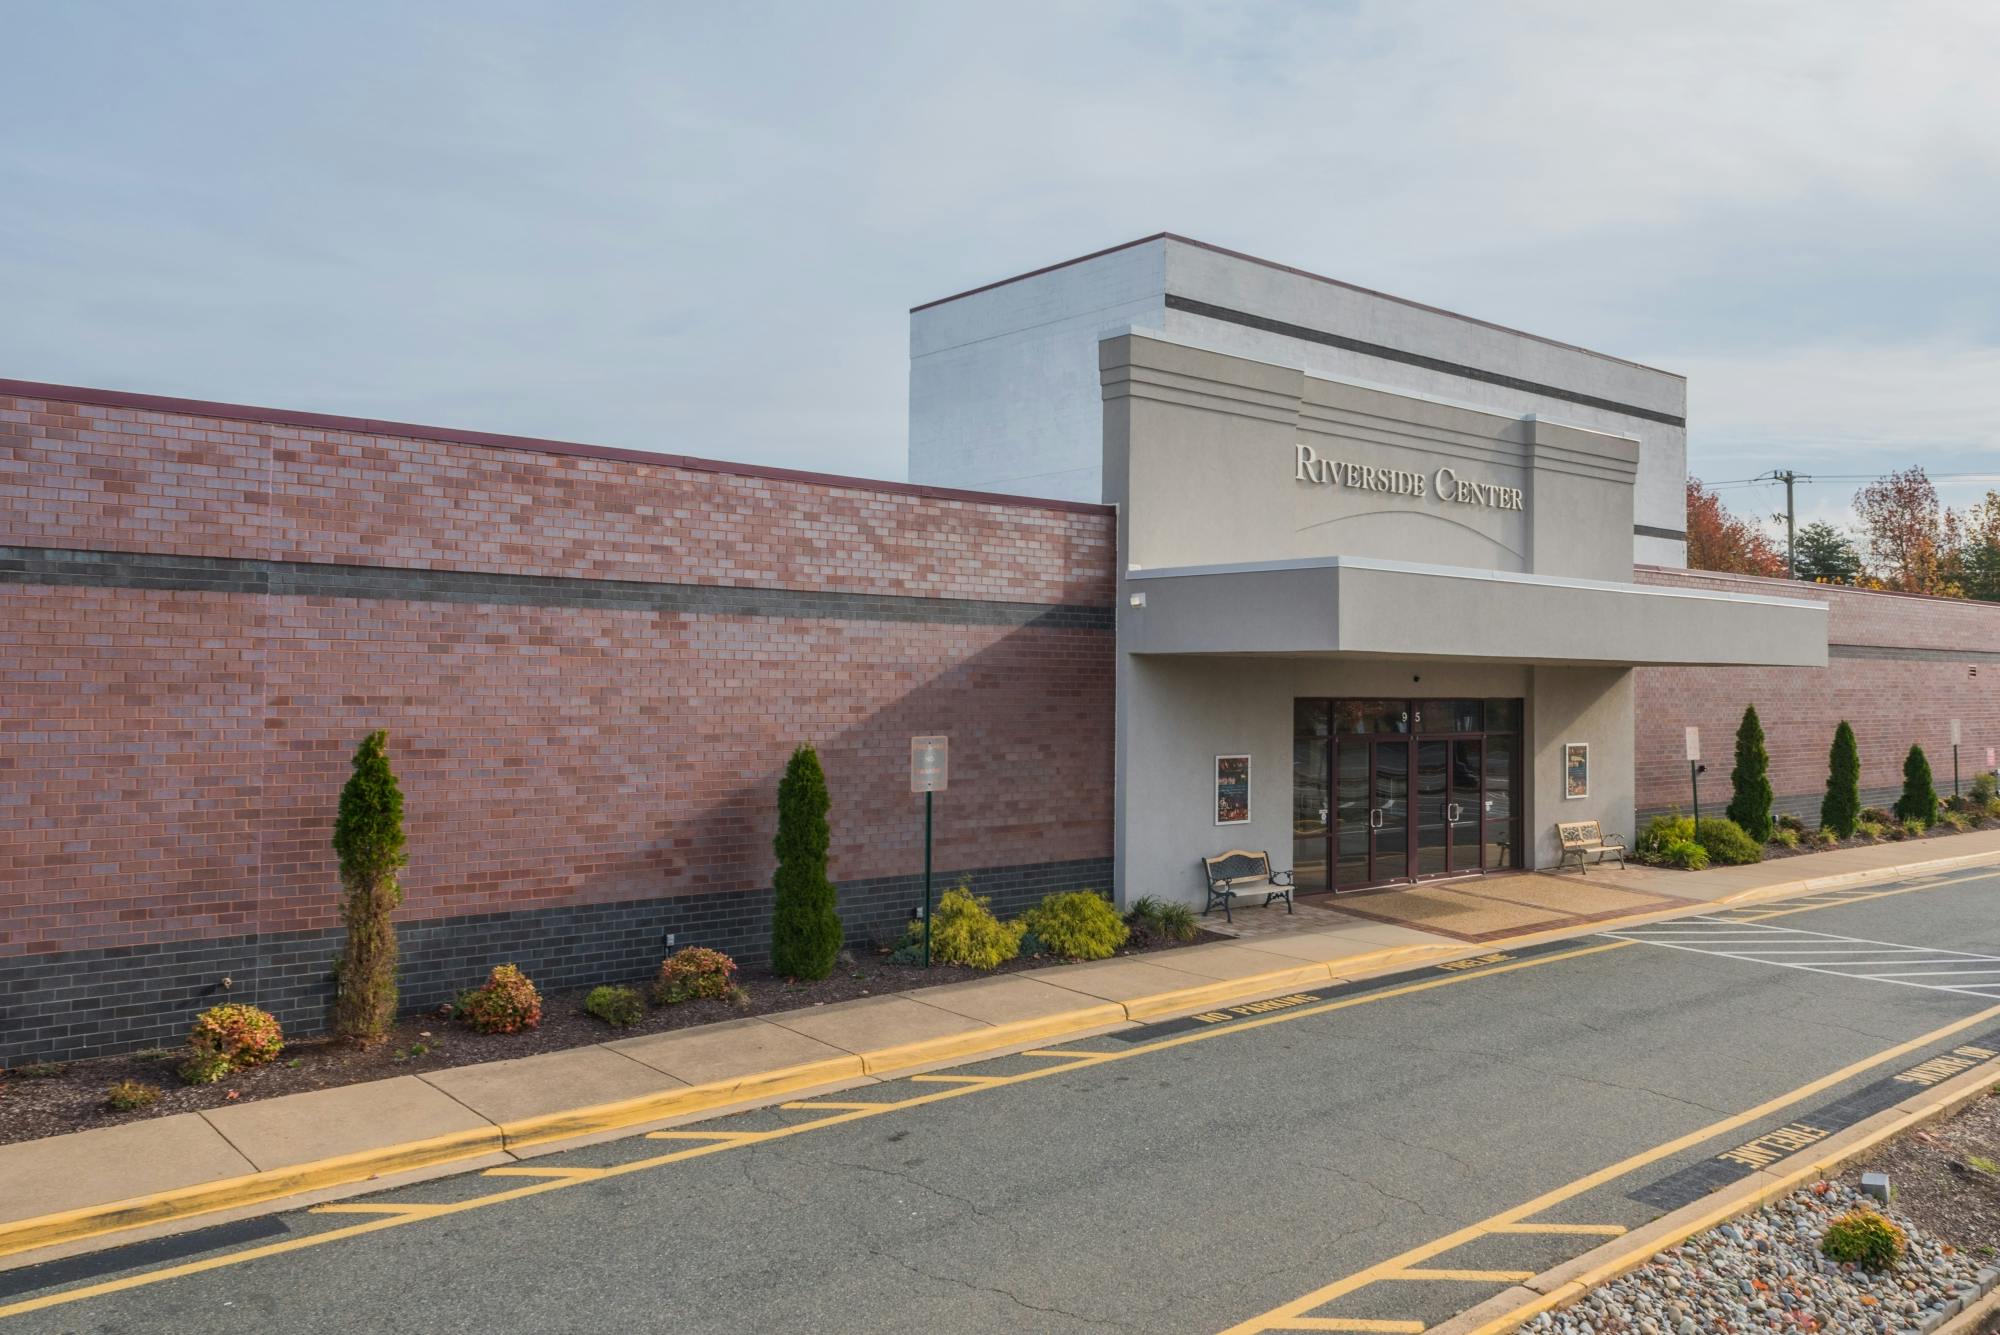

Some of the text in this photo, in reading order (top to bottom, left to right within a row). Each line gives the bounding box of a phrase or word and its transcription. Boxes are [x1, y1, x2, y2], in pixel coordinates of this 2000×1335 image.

[1192, 993, 1321, 1023] NO PARKING
[1893, 1045, 1999, 1086] NO PARKING
